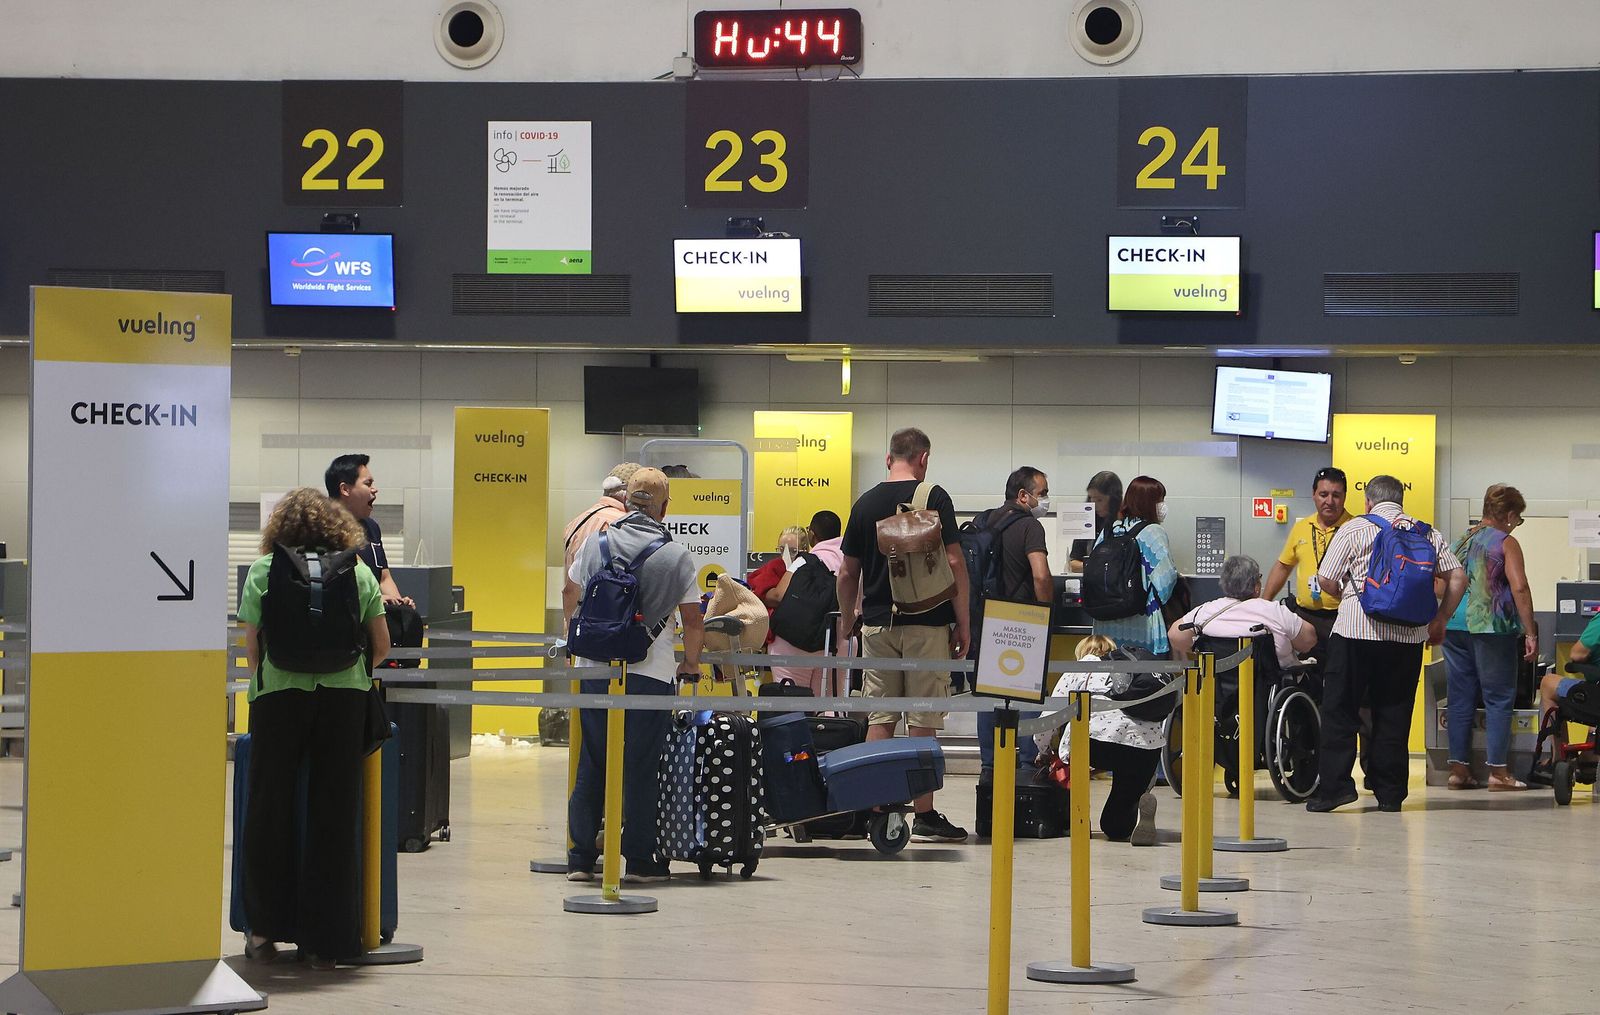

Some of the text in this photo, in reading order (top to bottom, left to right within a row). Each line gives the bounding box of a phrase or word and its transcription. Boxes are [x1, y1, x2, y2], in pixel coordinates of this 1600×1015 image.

[493, 130, 559, 140] info COVID-19
[301, 128, 384, 190] 22
[705, 130, 788, 193] 23
[1136, 126, 1226, 190] 24
[683, 251, 768, 264] CHECK-IN
[1117, 248, 1205, 262] CHECK-IN
[334, 261, 372, 276] WFS
[292, 282, 371, 292] Worldwide Flight Services
[738, 285, 790, 302] vueling
[1173, 284, 1227, 301] vueling
[118, 312, 196, 342] vueling
[71, 401, 197, 426] CHECK-IN
[475, 430, 525, 447] vueling
[796, 434, 827, 452] eling
[1355, 437, 1409, 455] vueling
[474, 472, 527, 483] CHECK-IN
[775, 477, 830, 487] CHECK-IN
[693, 492, 730, 505] vueling
[992, 632, 1036, 643] MANDATORY
[1003, 626, 1026, 634] MASKS
[1008, 640, 1032, 649] BOARD
